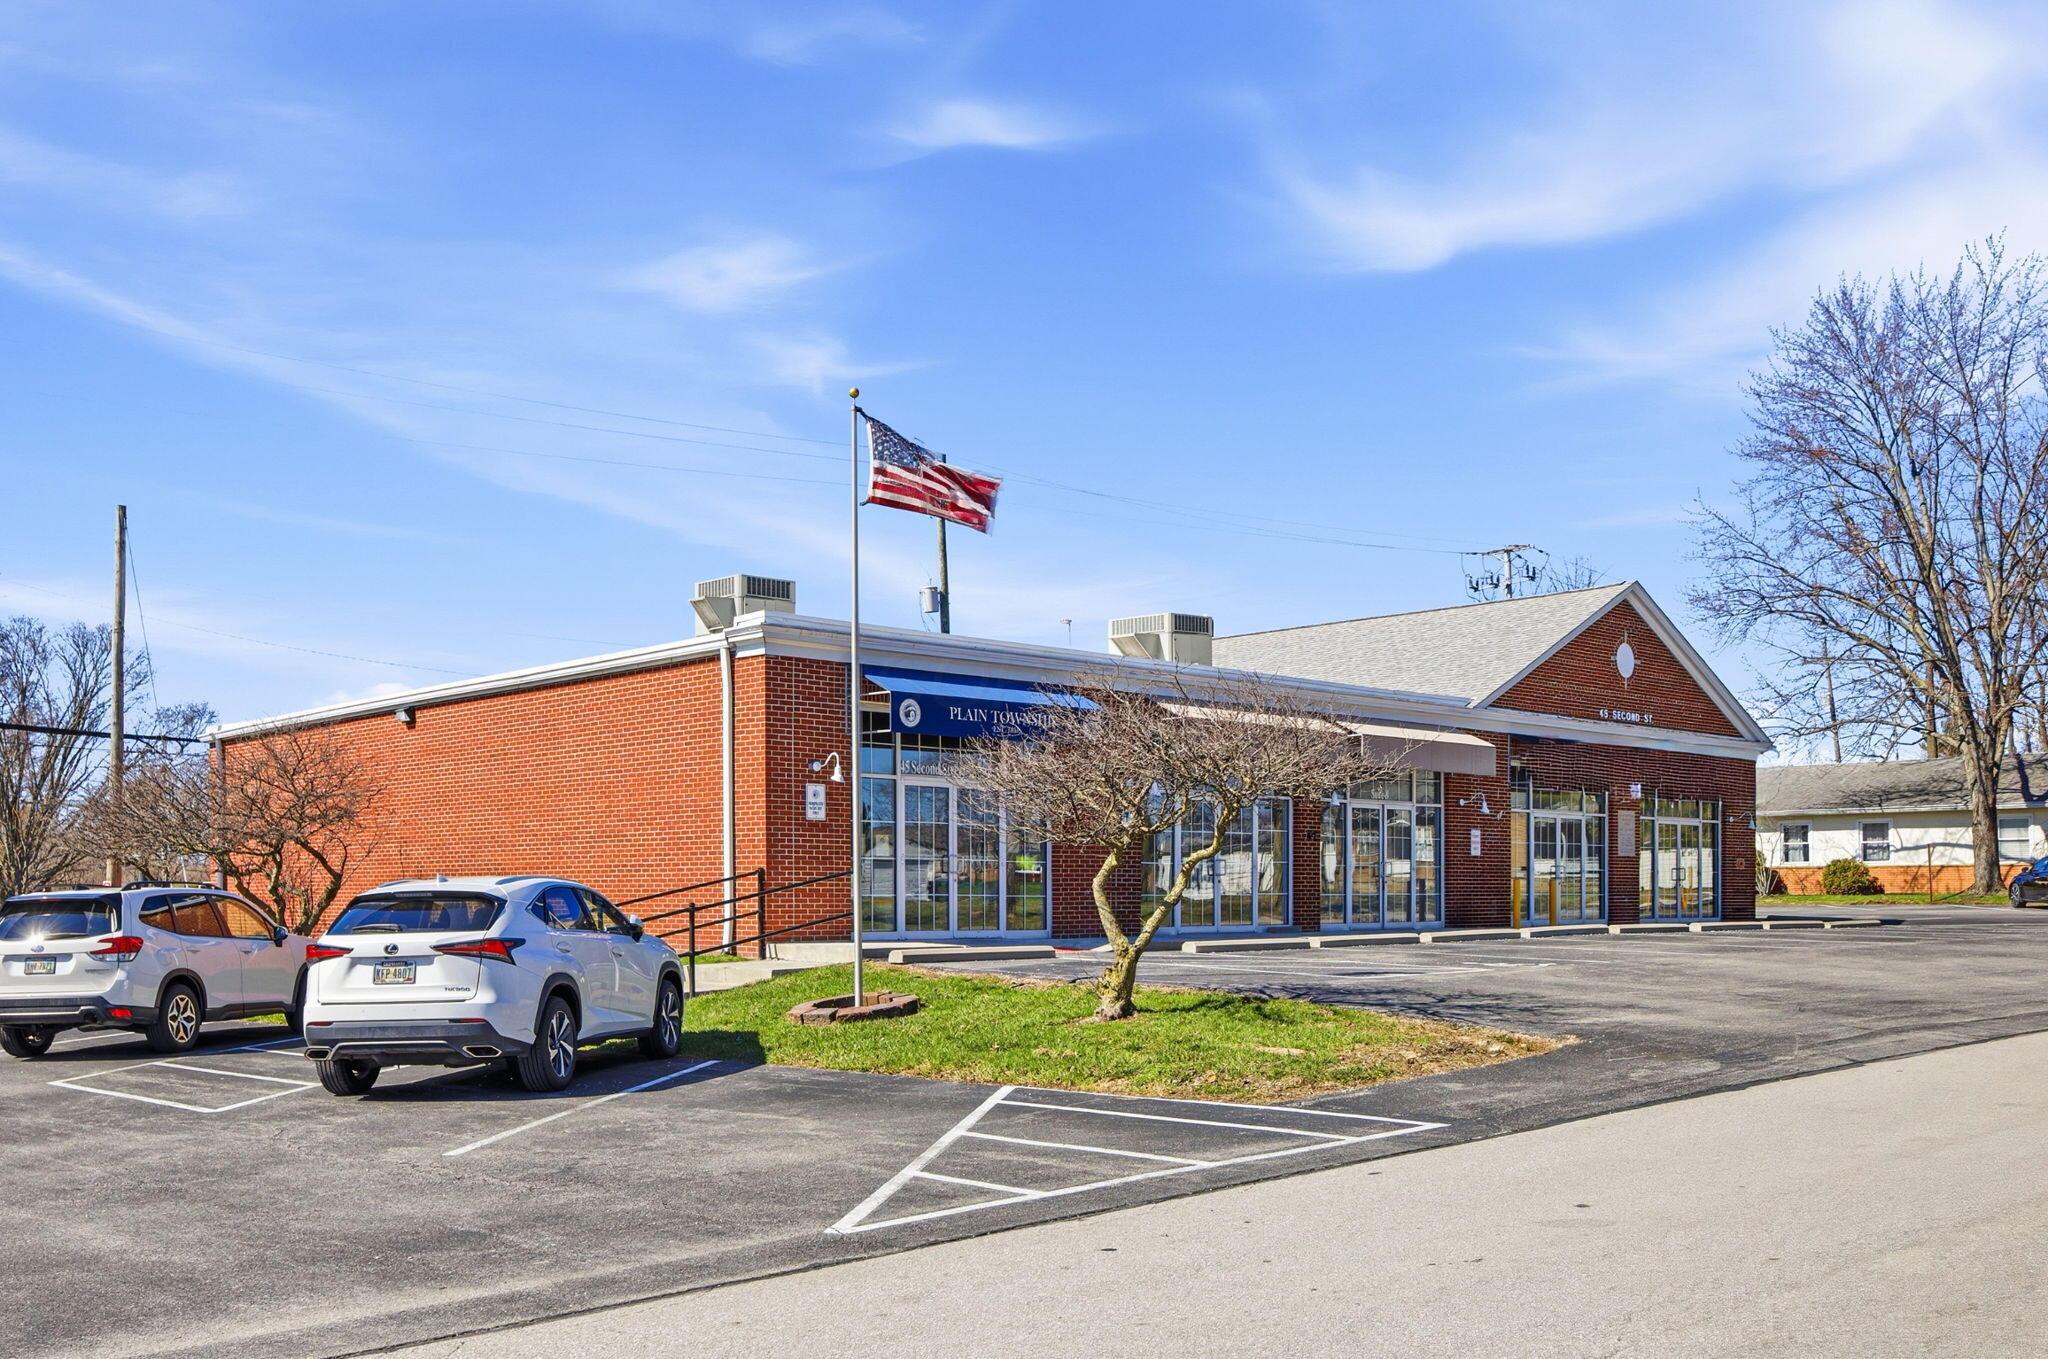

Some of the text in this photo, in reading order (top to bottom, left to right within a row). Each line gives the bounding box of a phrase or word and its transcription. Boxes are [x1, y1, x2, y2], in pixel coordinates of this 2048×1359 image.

[949, 706, 1057, 728] PLAIN TOWNSHI
[1600, 709, 1608, 718] 45
[1612, 710, 1640, 722] SECOND
[899, 760, 910, 773] 45
[911, 760, 941, 775] Second
